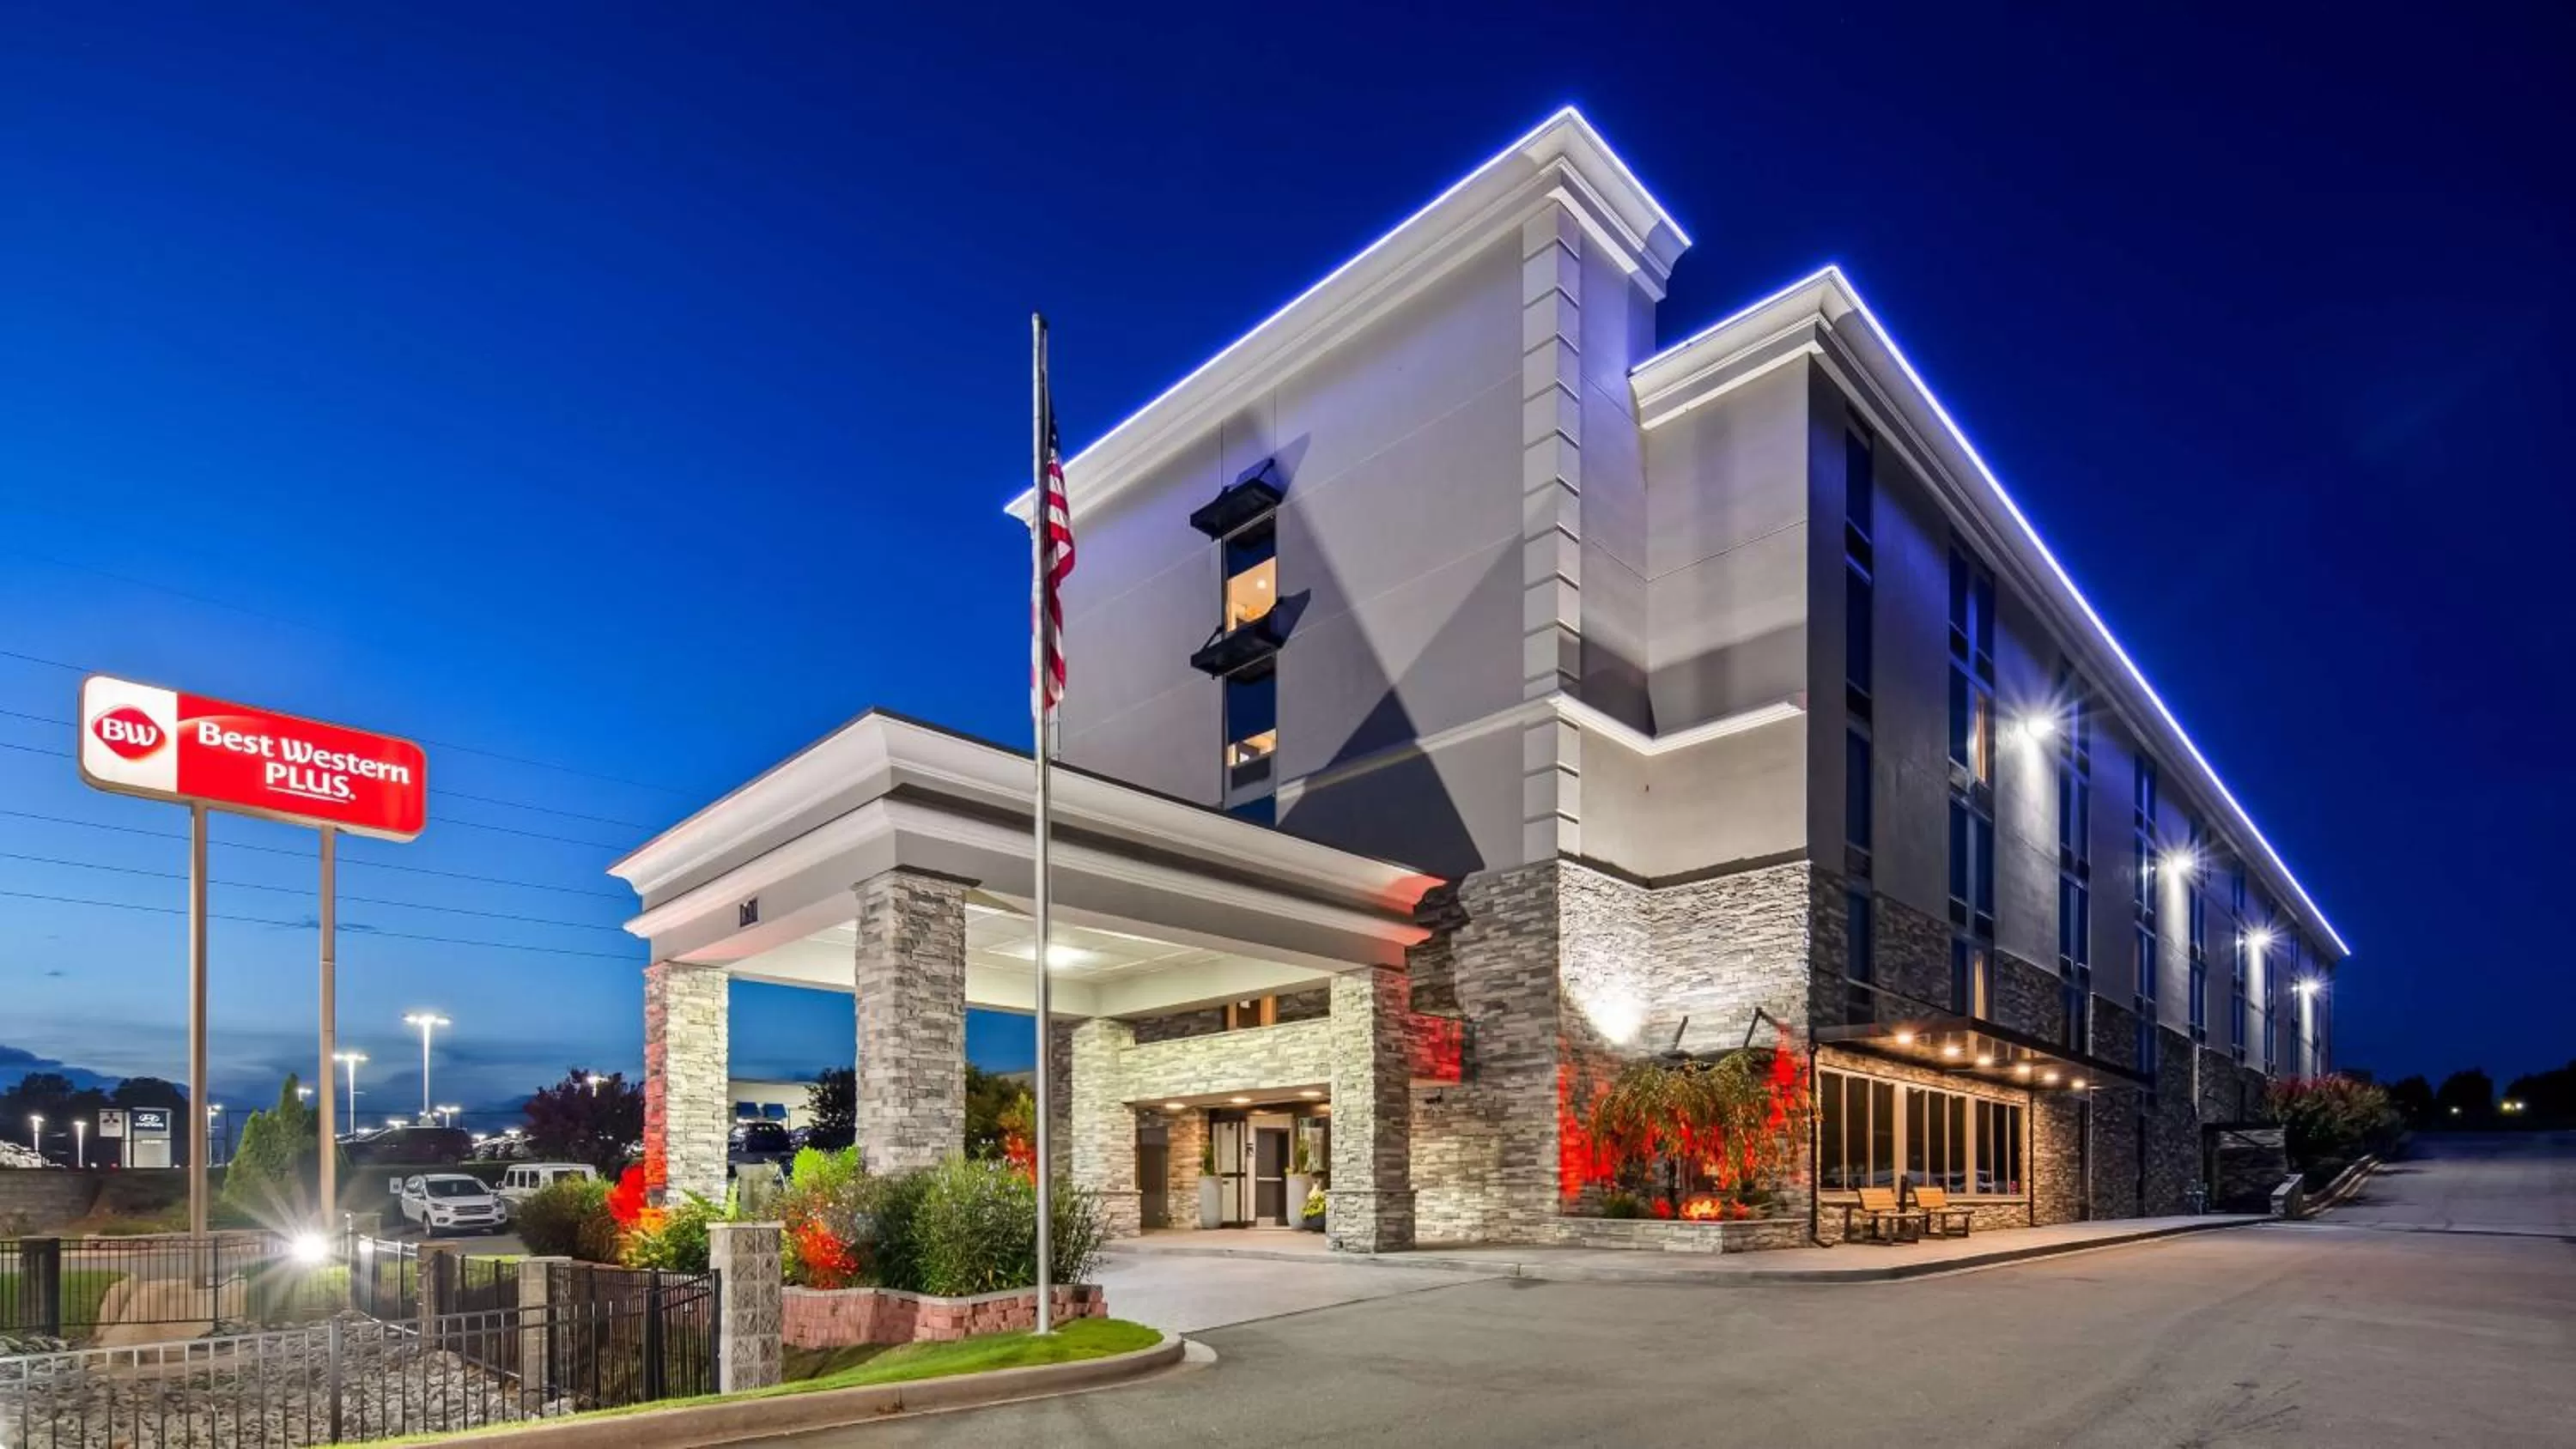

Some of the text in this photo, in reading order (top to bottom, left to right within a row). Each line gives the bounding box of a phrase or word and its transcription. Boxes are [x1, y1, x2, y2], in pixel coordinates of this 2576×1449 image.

[102, 717, 157, 746] BW
[198, 720, 410, 784] Best Western
